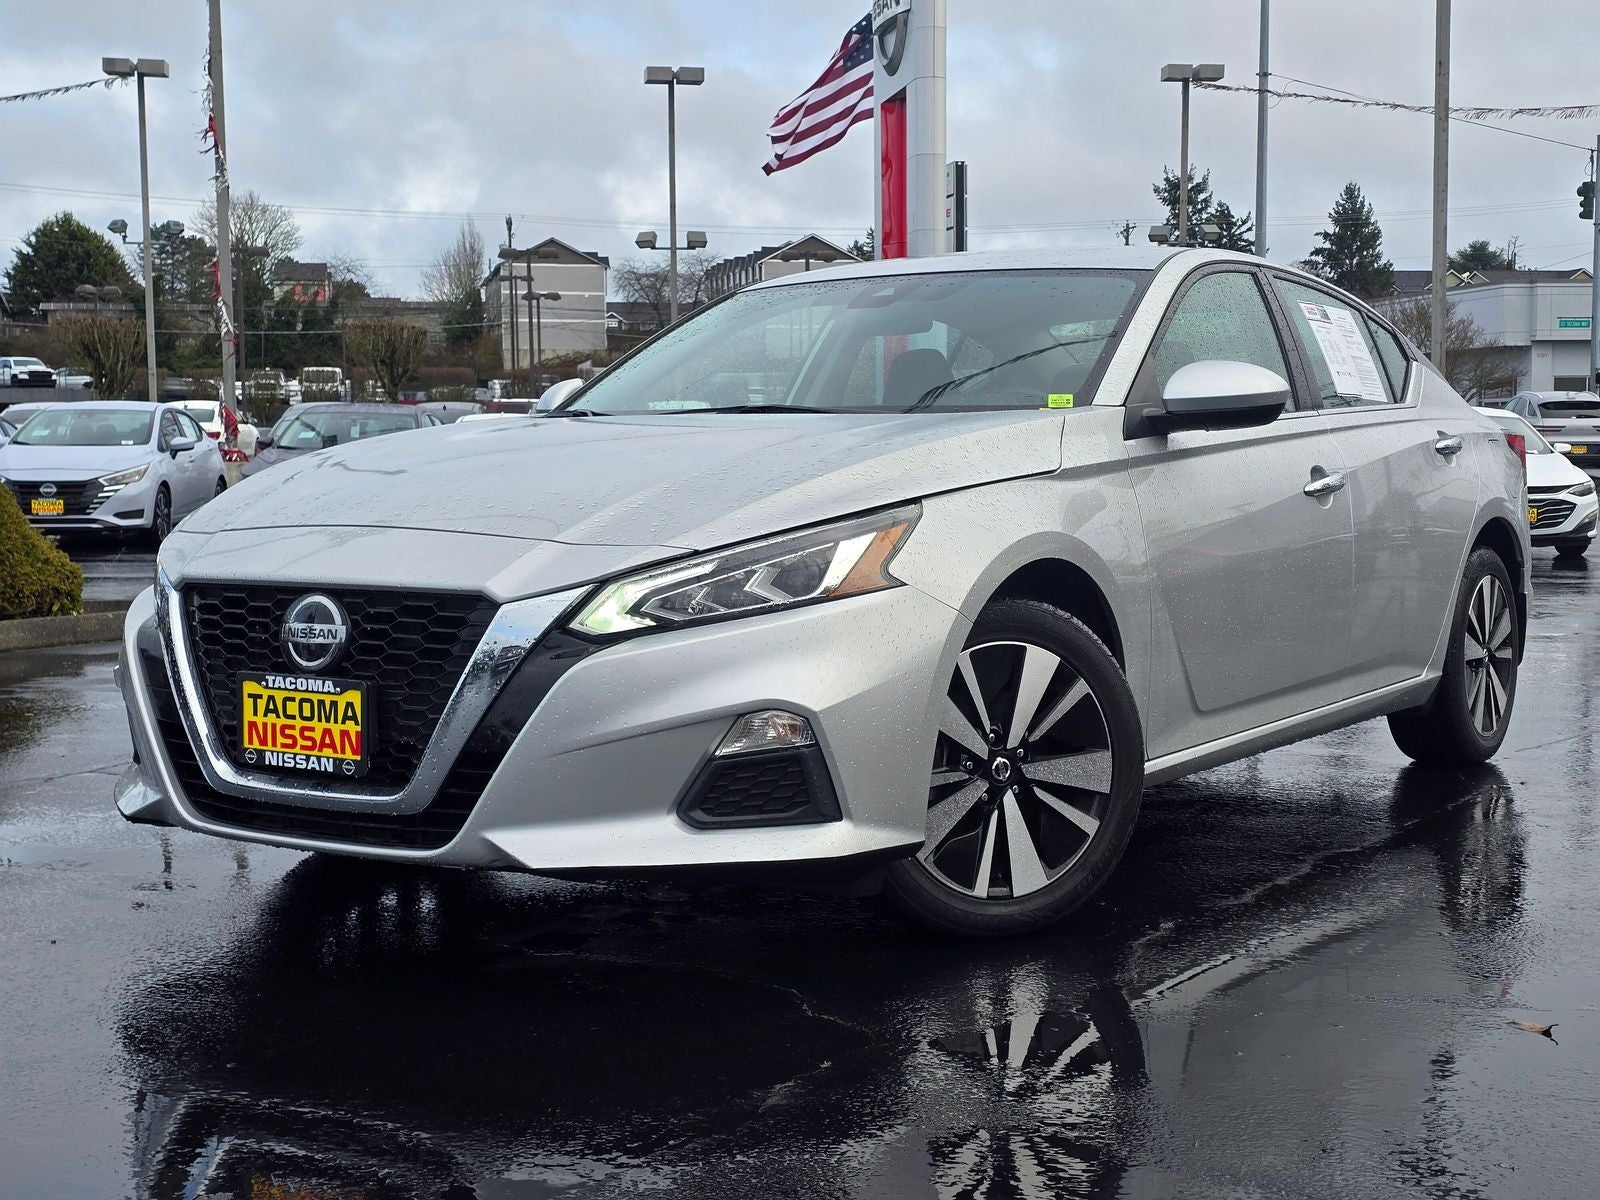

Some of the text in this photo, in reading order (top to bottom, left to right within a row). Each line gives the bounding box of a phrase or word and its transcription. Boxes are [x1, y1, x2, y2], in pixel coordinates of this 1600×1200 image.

[287, 626, 338, 641] NISSAN
[265, 675, 335, 692] TACOMA
[247, 692, 360, 726] TACOMA
[247, 720, 361, 756] NISSAN
[265, 751, 334, 772] NISSAN
